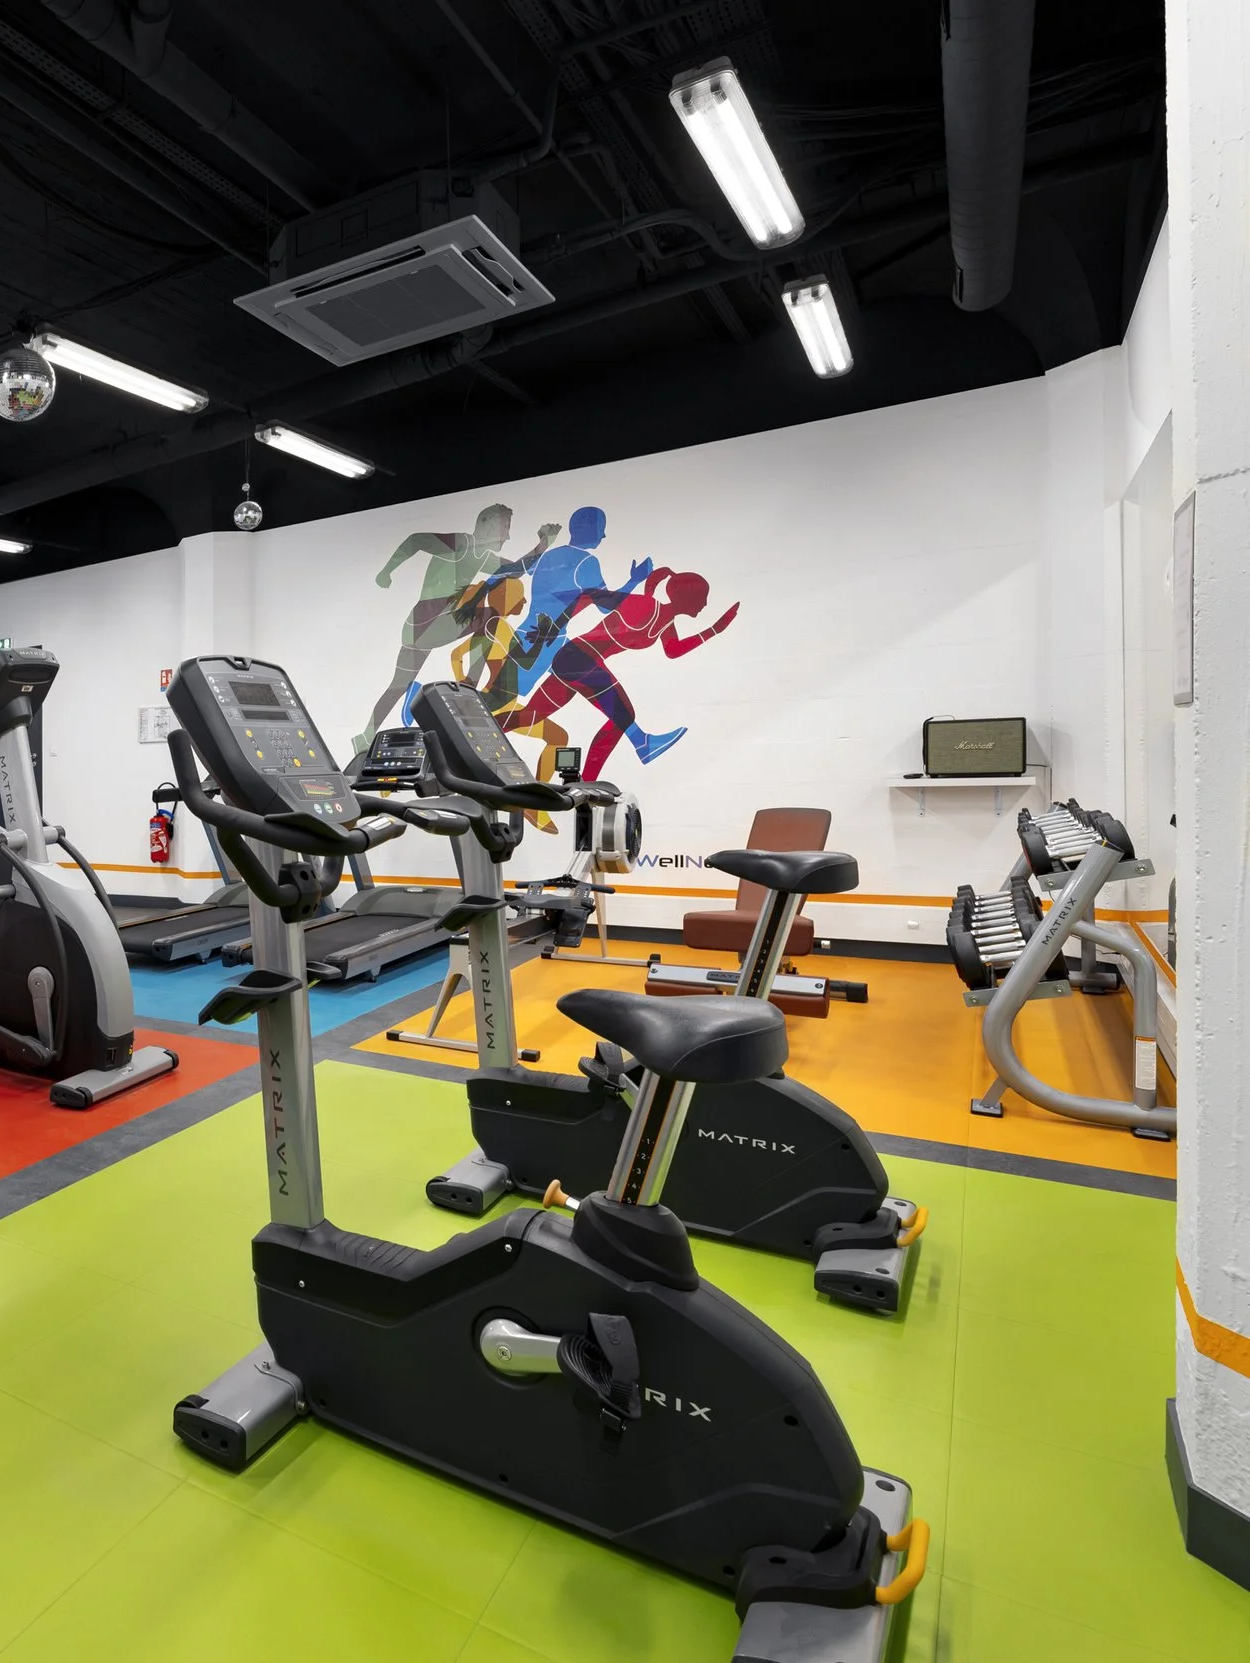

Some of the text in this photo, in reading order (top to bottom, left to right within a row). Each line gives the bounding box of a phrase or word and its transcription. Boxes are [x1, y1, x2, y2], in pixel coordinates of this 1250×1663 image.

[954, 740, 996, 750] Marshall
[0, 756, 16, 823] MATRIX
[1041, 898, 1077, 946] MATRIX
[479, 951, 495, 1049] MATRIX
[270, 1049, 289, 1196] MATRIX
[698, 1129, 796, 1154] MATRIX
